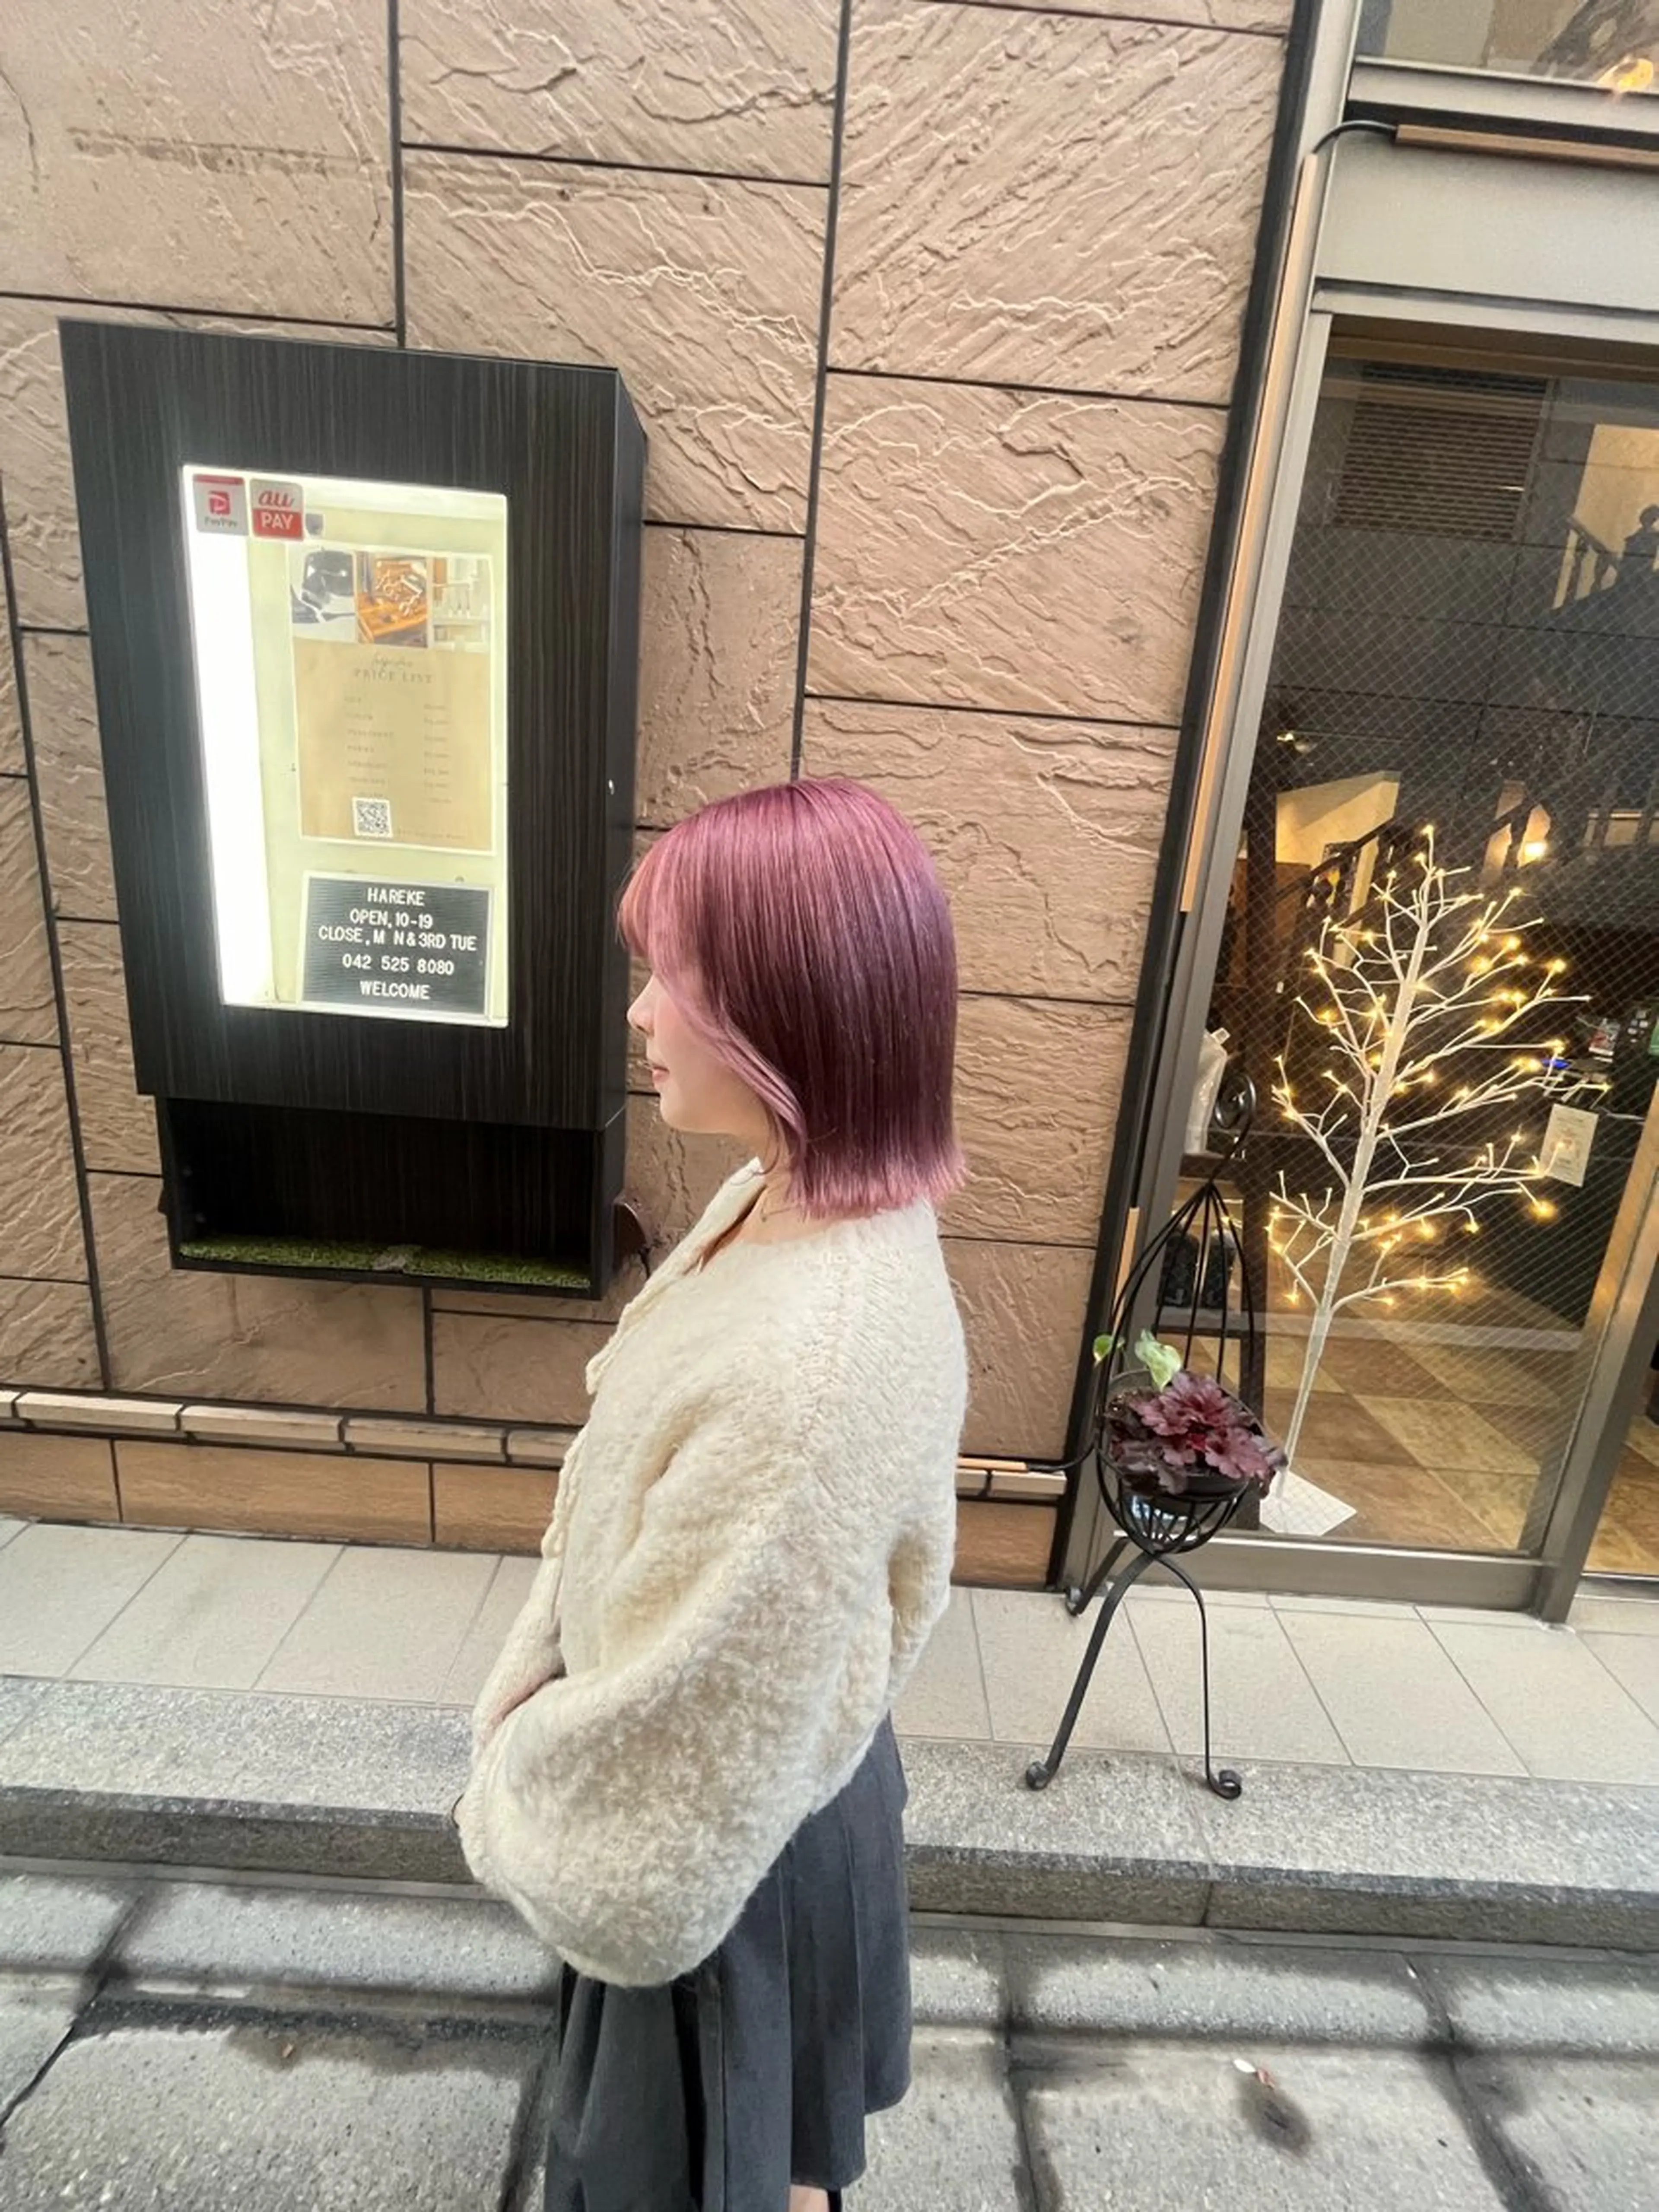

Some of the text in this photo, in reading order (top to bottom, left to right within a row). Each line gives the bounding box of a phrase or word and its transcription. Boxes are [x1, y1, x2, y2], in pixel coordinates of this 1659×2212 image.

[259, 490, 295, 507] au
[261, 512, 294, 530] PAY
[367, 887, 426, 906] HAREKE
[449, 934, 478, 951] TUE
[342, 953, 454, 976] 042 525 8080
[359, 980, 431, 1000] WELCOME
